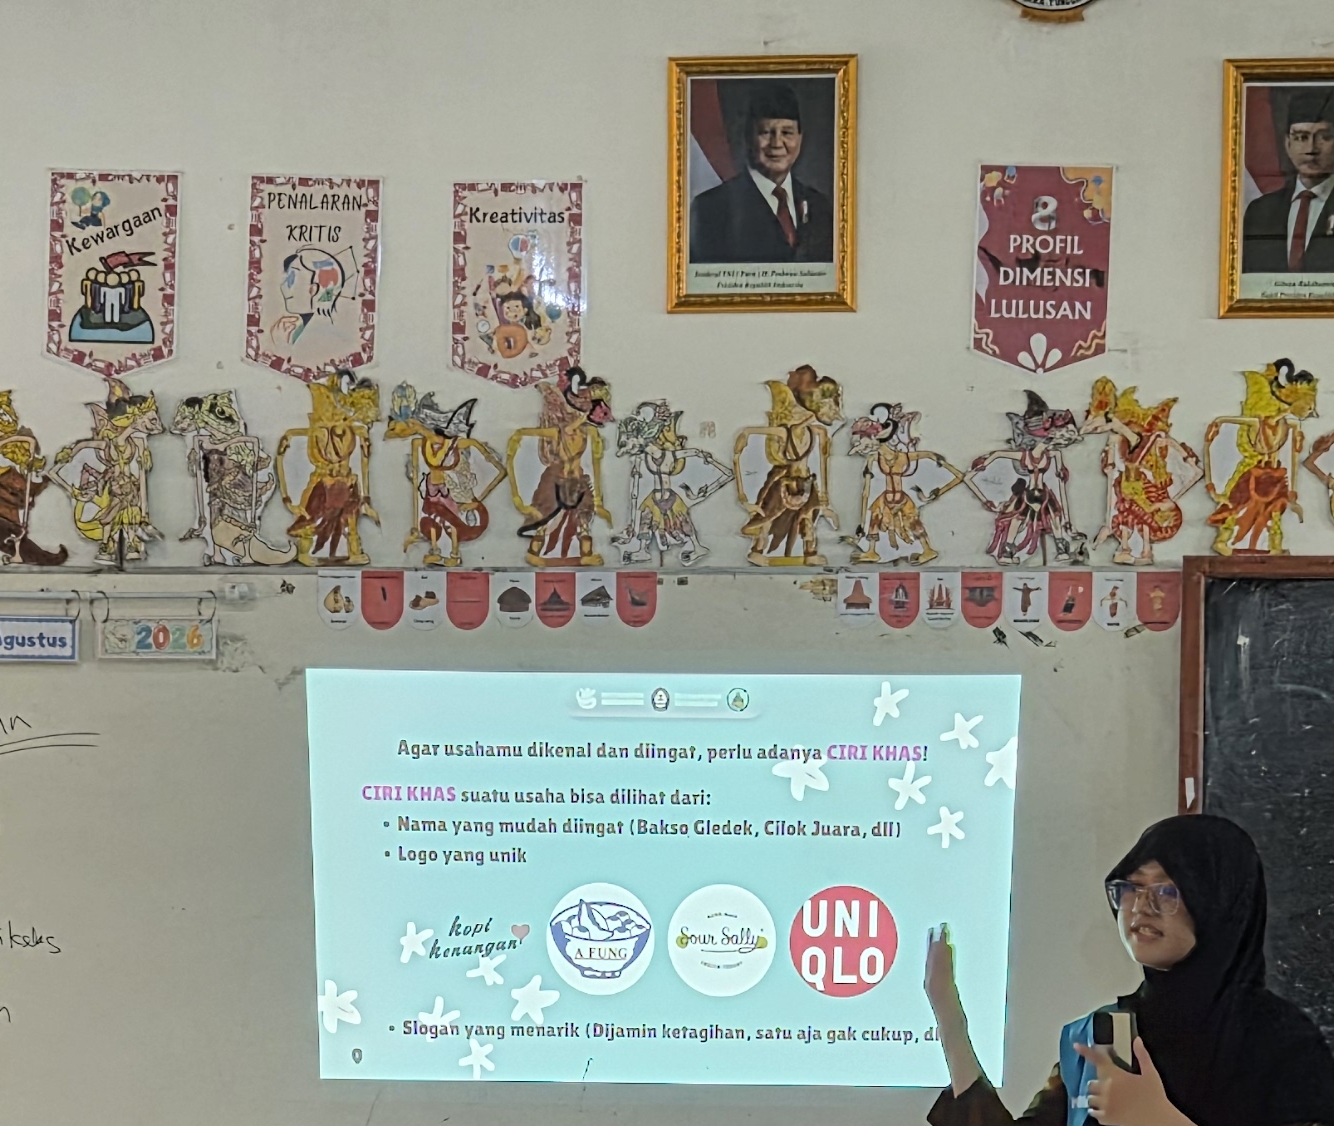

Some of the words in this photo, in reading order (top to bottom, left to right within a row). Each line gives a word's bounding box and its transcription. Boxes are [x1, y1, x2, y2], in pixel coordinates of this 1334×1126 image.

[268, 192, 363, 211] PENALARAN
[469, 206, 565, 224] Kreativitas
[65, 206, 163, 256] Kewargaan
[286, 226, 341, 242] KRITIS
[1009, 234, 1083, 255] PROFIL
[999, 265, 1091, 287] DIMENSI
[989, 298, 1091, 320] LULUSAN
[135, 624, 203, 650] 2026
[398, 740, 440, 759] Agar
[444, 741, 522, 758] usahamu
[527, 743, 591, 758] dikenal
[597, 743, 628, 759] dan
[634, 743, 702, 763] diingat,
[708, 744, 752, 763] perlu
[757, 744, 822, 764] adanya
[827, 745, 867, 760] CIRI
[872, 745, 928, 761] KHAS!
[362, 786, 402, 801] CIRI
[407, 786, 456, 801] KHAS
[461, 789, 509, 803] suatu
[515, 788, 565, 804] usaha
[571, 789, 604, 804] bisa
[610, 789, 665, 806] dilihat
[670, 790, 711, 806] dari:
[397, 816, 447, 832] Nama
[452, 820, 494, 836] yang
[499, 819, 557, 833] mudah
[563, 819, 623, 838] diingat
[630, 819, 688, 836] (Bakso
[693, 820, 759, 837] Gledek,
[764, 821, 806, 836] Cilok
[812, 821, 866, 839] Juara,
[871, 822, 901, 838] dll)
[398, 846, 438, 865] Logo
[443, 849, 484, 865] yang
[490, 848, 526, 863] unik
[449, 916, 493, 937] kopi
[801, 900, 878, 937] UNI
[429, 939, 517, 958] kenangan
[677, 926, 717, 946] Sour
[721, 926, 766, 952] Sally
[589, 948, 627, 960] FUNG
[801, 947, 885, 991] QLO
[403, 1021, 459, 1039] Slogan
[465, 1023, 505, 1039] yang
[511, 1023, 580, 1038] menarik
[586, 1023, 656, 1040] (Dijamin
[662, 1025, 751, 1041] ketagihan,
[756, 1027, 792, 1040] satu
[797, 1028, 822, 1043] aja
[827, 1028, 857, 1043] gak
[862, 1027, 919, 1045] cukup,
